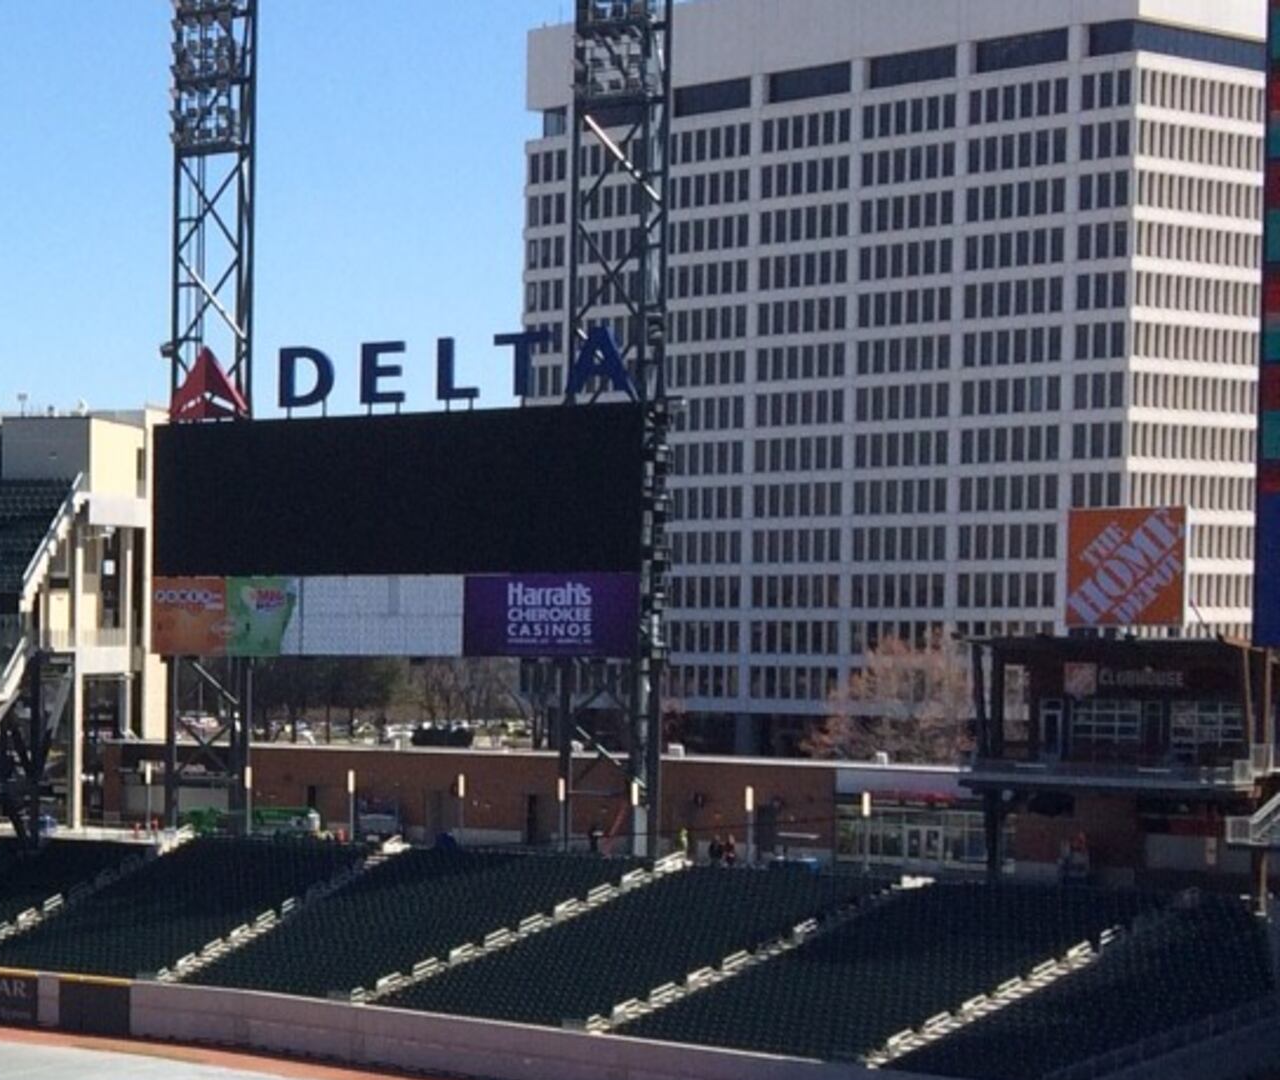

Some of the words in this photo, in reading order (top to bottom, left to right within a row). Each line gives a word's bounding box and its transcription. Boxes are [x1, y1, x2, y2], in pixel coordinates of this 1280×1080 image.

[277, 326, 642, 408] DELTA
[1066, 508, 1185, 624] HOME
[507, 582, 592, 606] Harrah's
[507, 607, 592, 622] CHEROKEE
[507, 623, 592, 636] CASINOS
